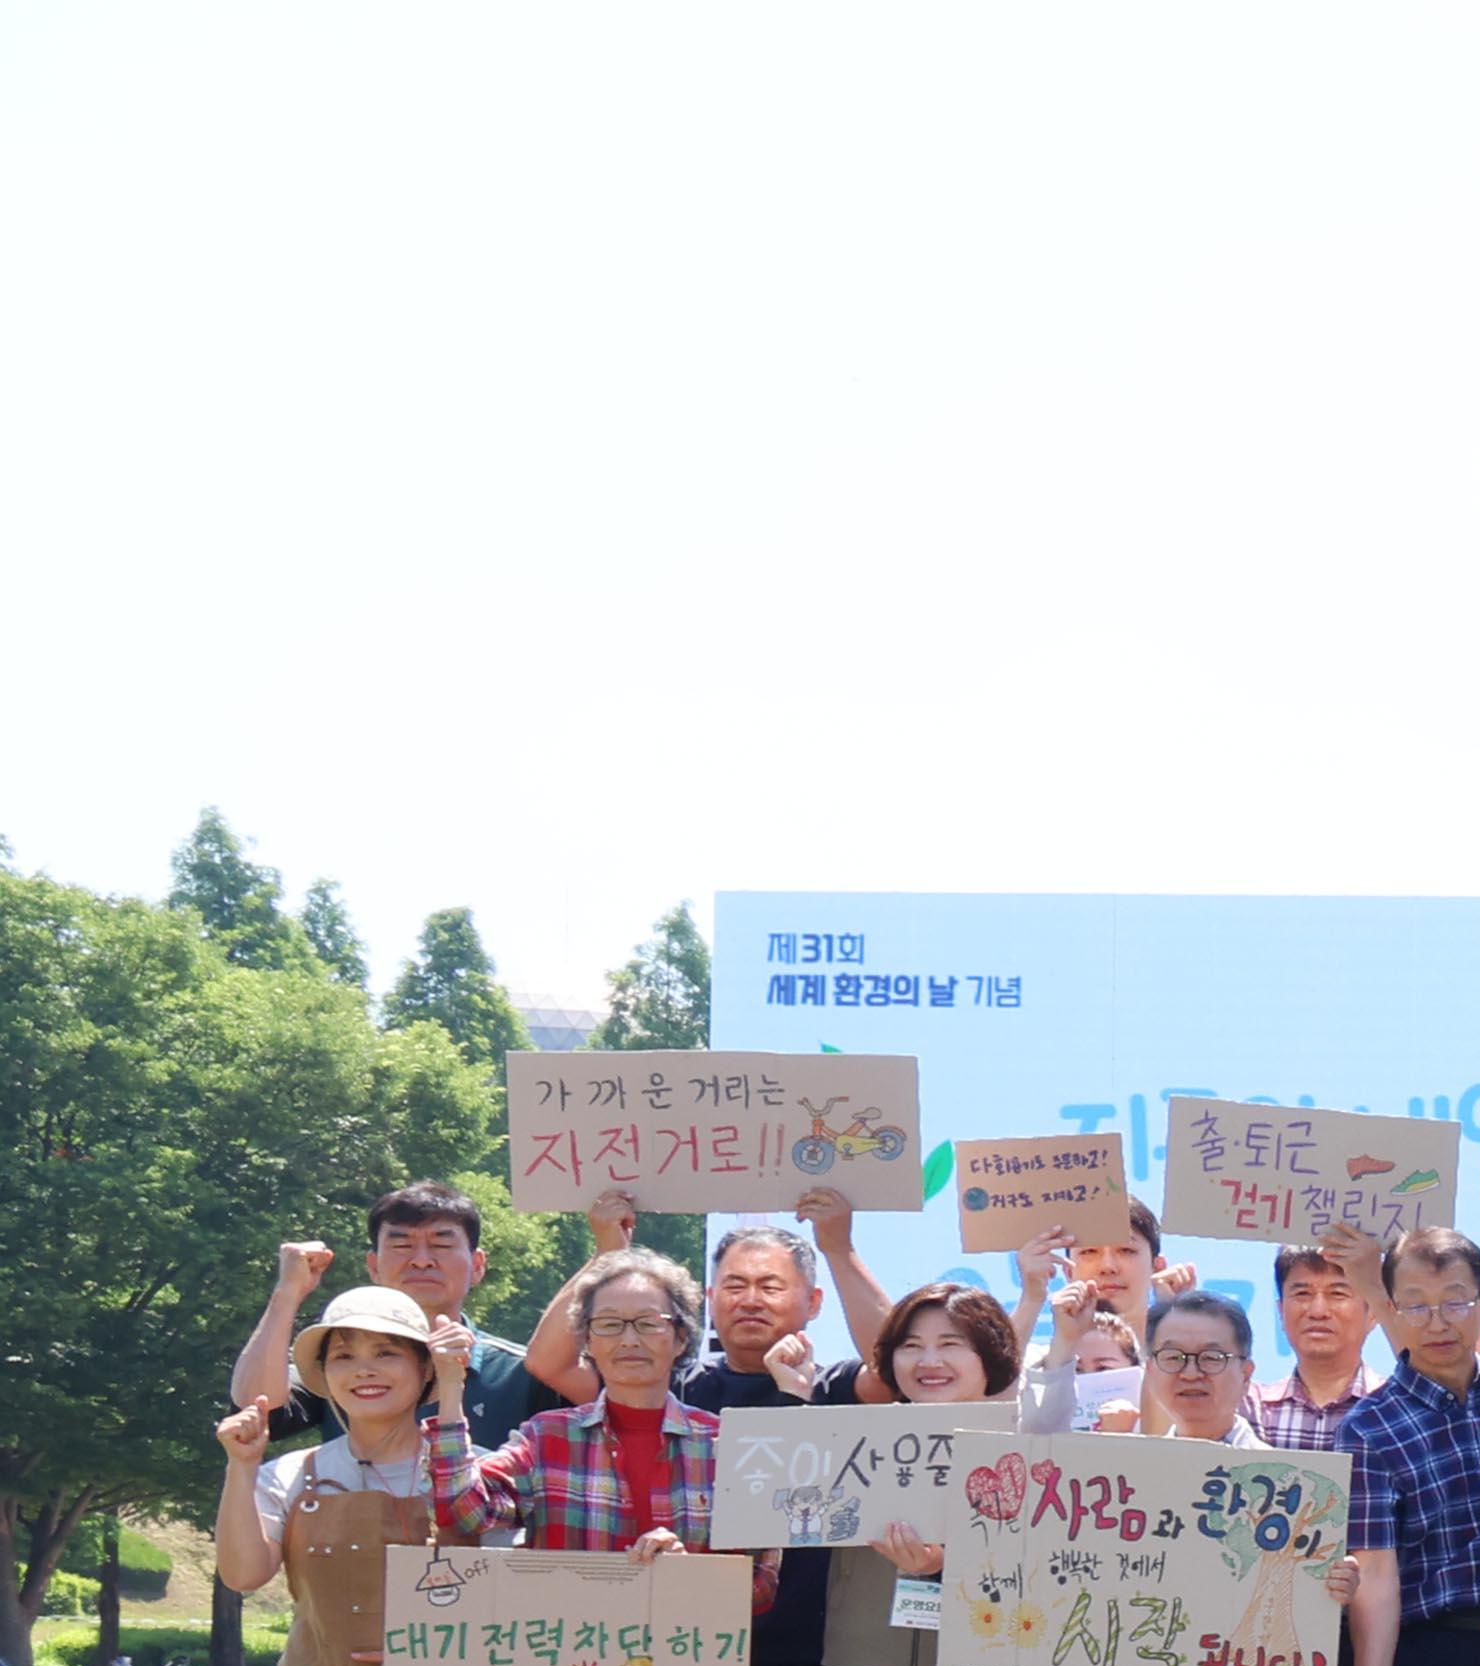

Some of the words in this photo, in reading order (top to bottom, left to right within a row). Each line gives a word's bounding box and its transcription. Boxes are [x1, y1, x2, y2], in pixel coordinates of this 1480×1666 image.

[767, 933, 864, 965] 제31회
[767, 974, 824, 1007] 세계
[833, 974, 920, 1007] 환경의
[928, 974, 957, 1004] 날
[965, 975, 1021, 1008] 기념
[691, 1075, 784, 1109] 거리는
[525, 1123, 784, 1186] 자전거로!!
[1220, 1179, 1292, 1229] 걷기
[1302, 1185, 1422, 1240] 챌린지
[1031, 1468, 1184, 1542] 사람과
[1193, 1464, 1320, 1558] 환경이
[977, 1562, 1023, 1602] 함께
[1049, 1551, 1103, 1585] 행복한
[1117, 1551, 1167, 1584] 것에서
